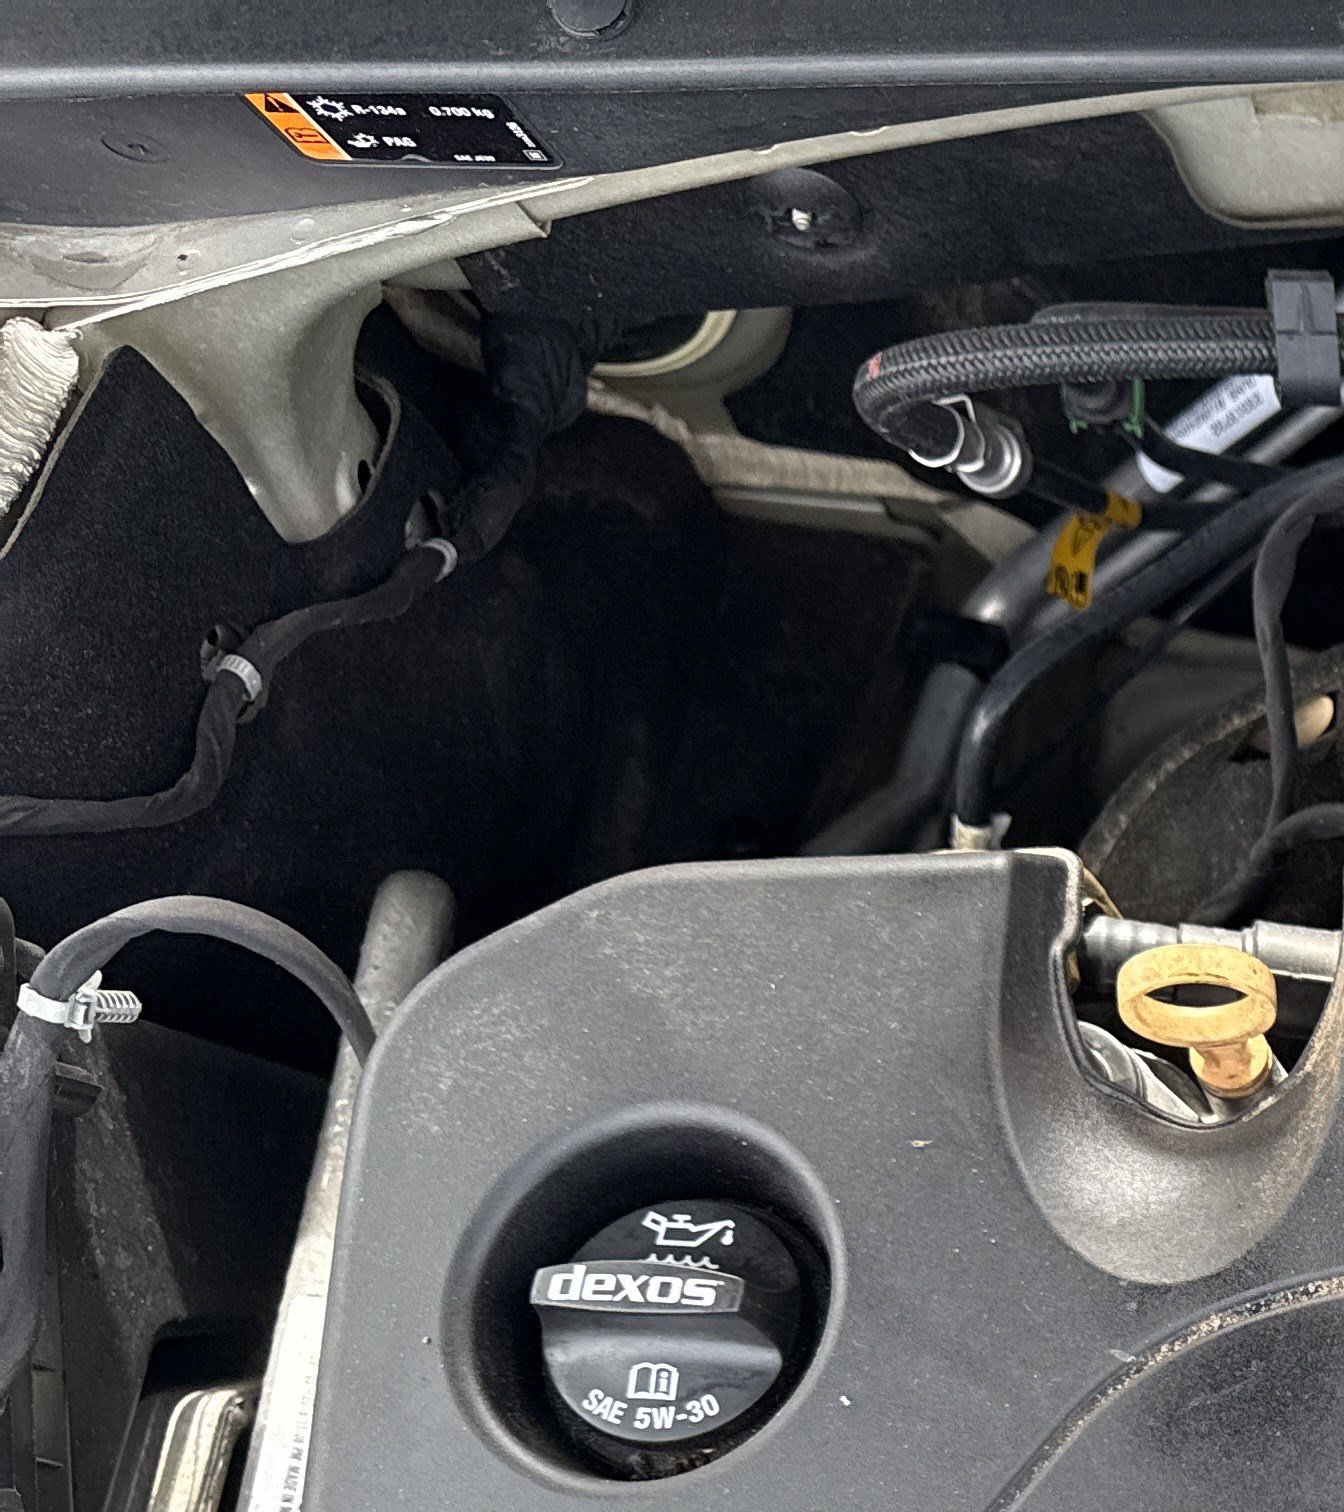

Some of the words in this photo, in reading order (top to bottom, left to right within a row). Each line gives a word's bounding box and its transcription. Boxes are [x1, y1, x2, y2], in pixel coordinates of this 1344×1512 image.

[350, 102, 407, 117] R-134a
[429, 104, 471, 118] 0.700
[382, 135, 418, 148] PAG
[581, 1387, 629, 1425] SAE
[633, 1392, 721, 1430] 5W-30
[283, 1465, 302, 1492] MADE
